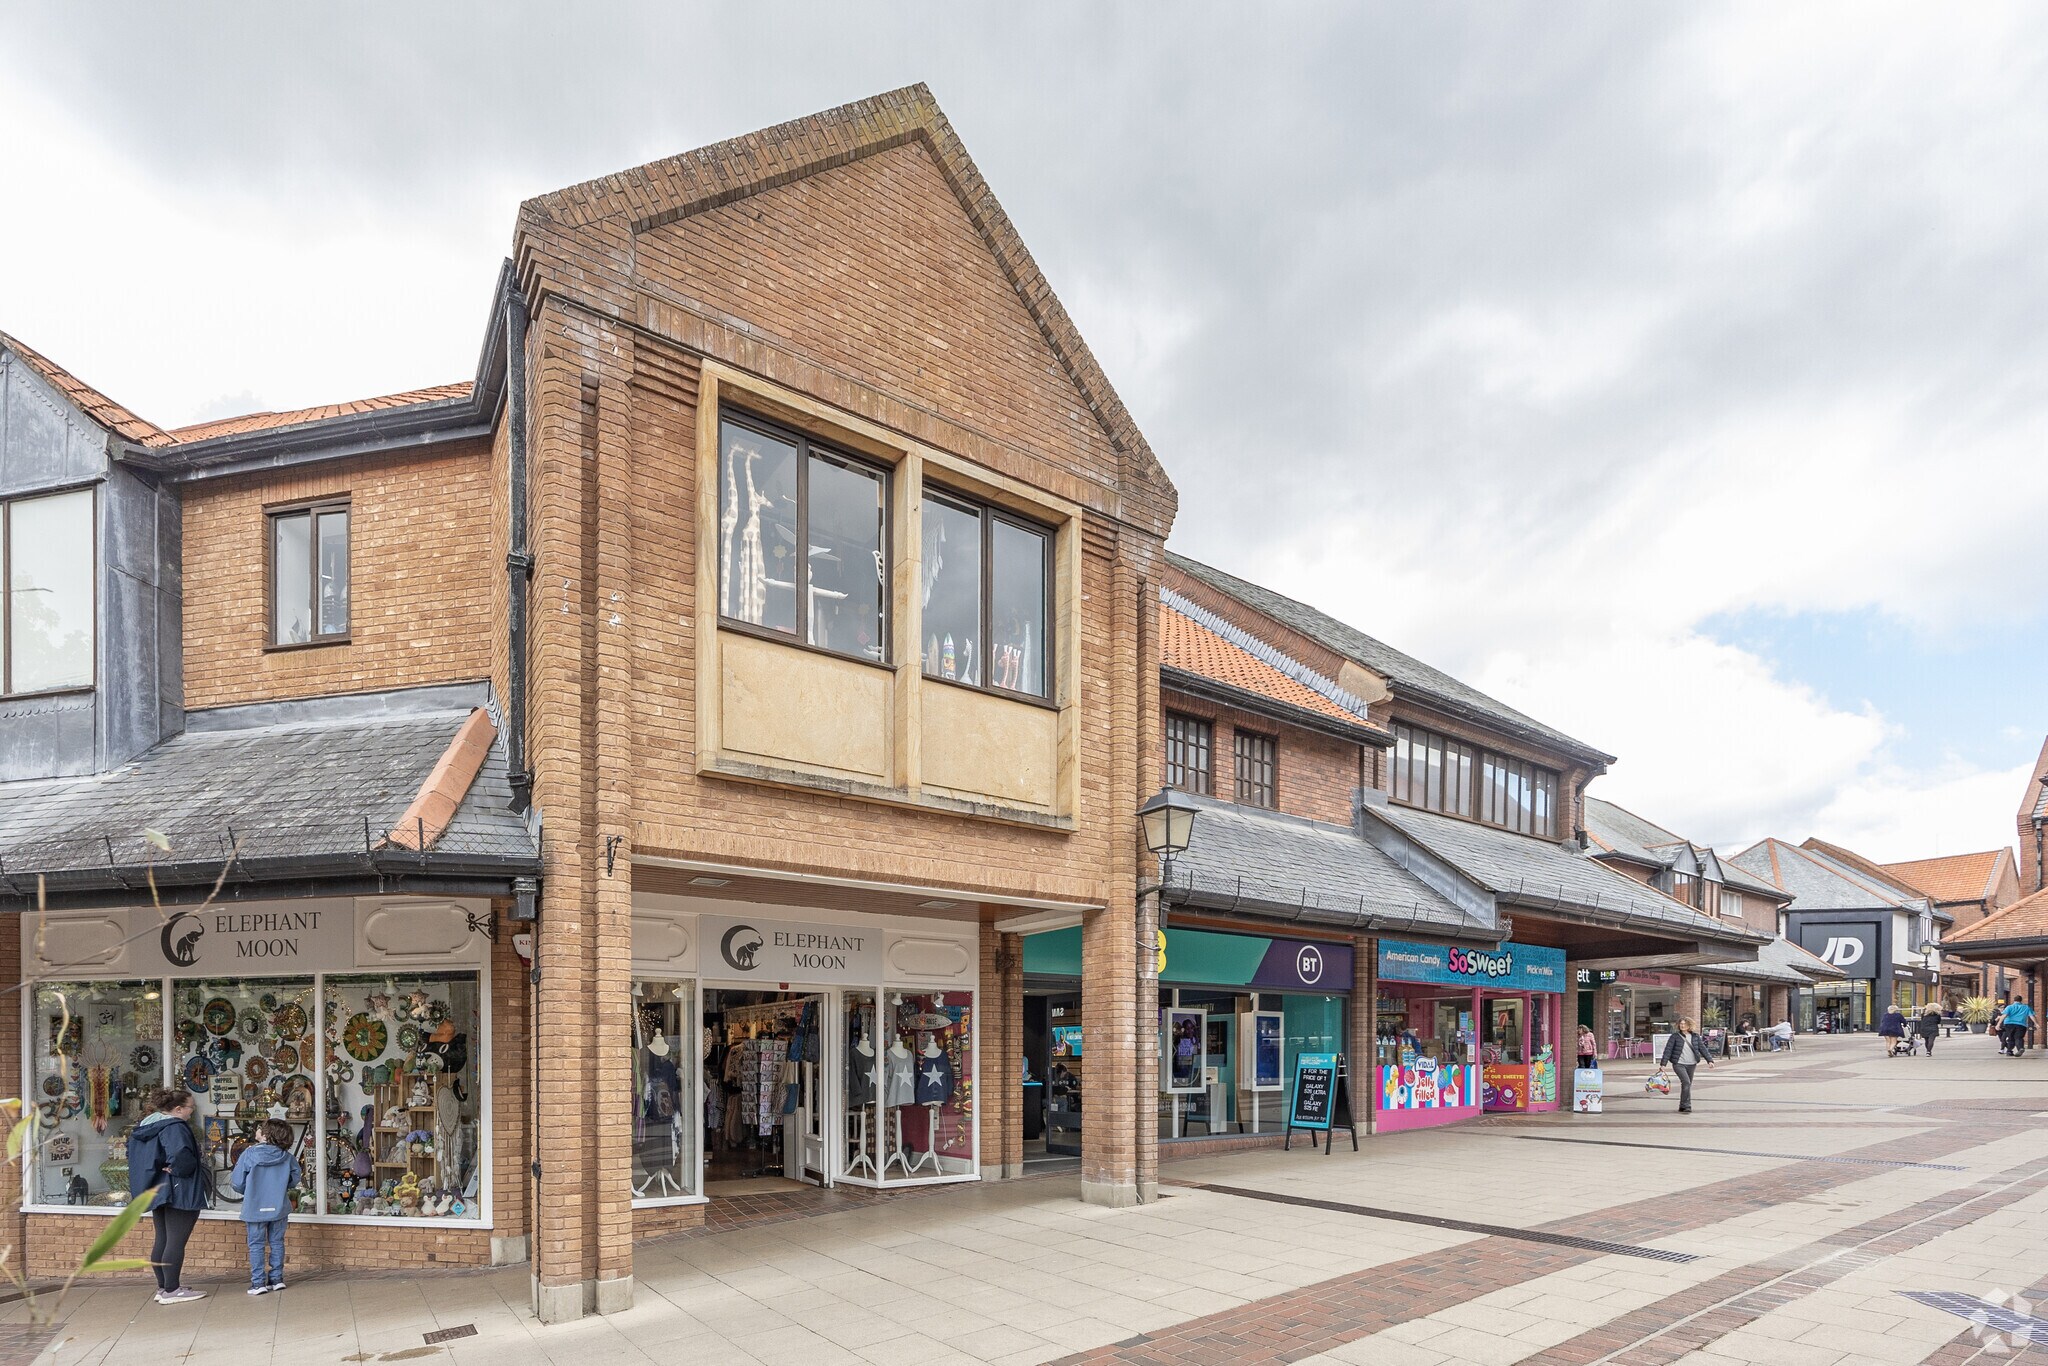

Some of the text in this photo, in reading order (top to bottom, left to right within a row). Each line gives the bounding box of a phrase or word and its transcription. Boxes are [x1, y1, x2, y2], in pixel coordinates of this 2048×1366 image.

[215, 912, 321, 933] ELEPHANT
[236, 939, 299, 957] MOON
[773, 931, 864, 951] ELEPHANT
[1386, 950, 1440, 967] American Candy
[1819, 937, 1863, 965] JD
[793, 953, 846, 969] MOON
[1303, 957, 1317, 972] BT
[1418, 1061, 1434, 1069] VIDAL
[1417, 1075, 1435, 1090] Jelly
